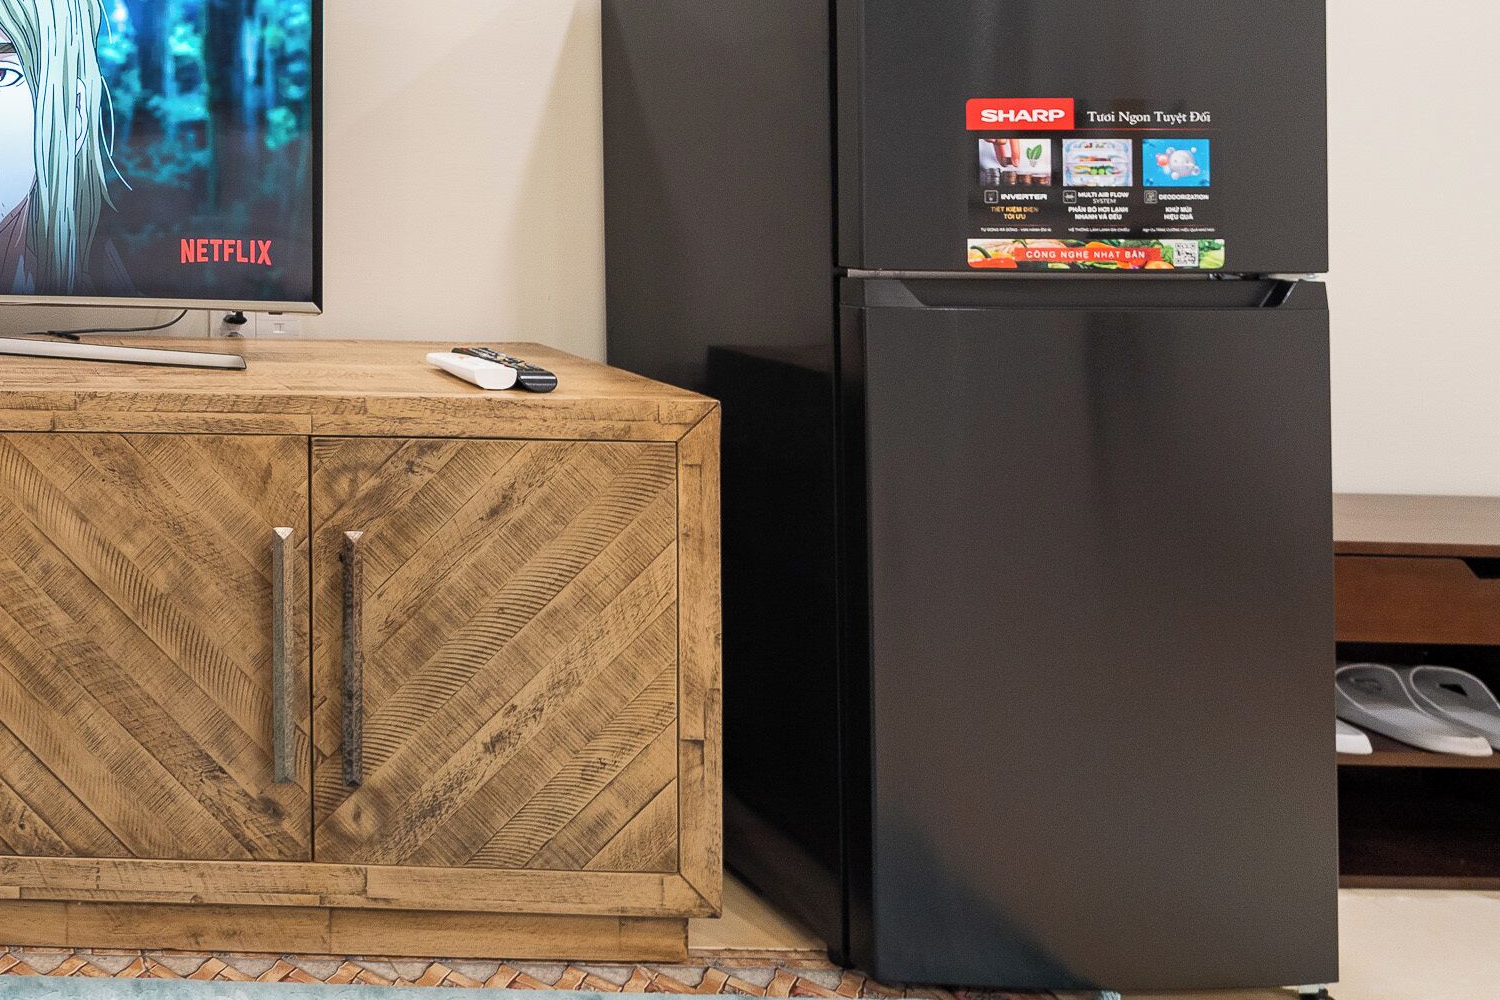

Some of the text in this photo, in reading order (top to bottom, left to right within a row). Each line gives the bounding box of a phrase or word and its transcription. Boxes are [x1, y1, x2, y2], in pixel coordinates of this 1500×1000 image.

[980, 108, 1066, 123] SHARP
[1086, 110, 1116, 122] Tươi
[1118, 110, 1151, 125] Ngon
[1153, 110, 1187, 125] Tuyệt
[180, 238, 273, 266] NETFLIX
[1025, 249, 1057, 259] CÔNG
